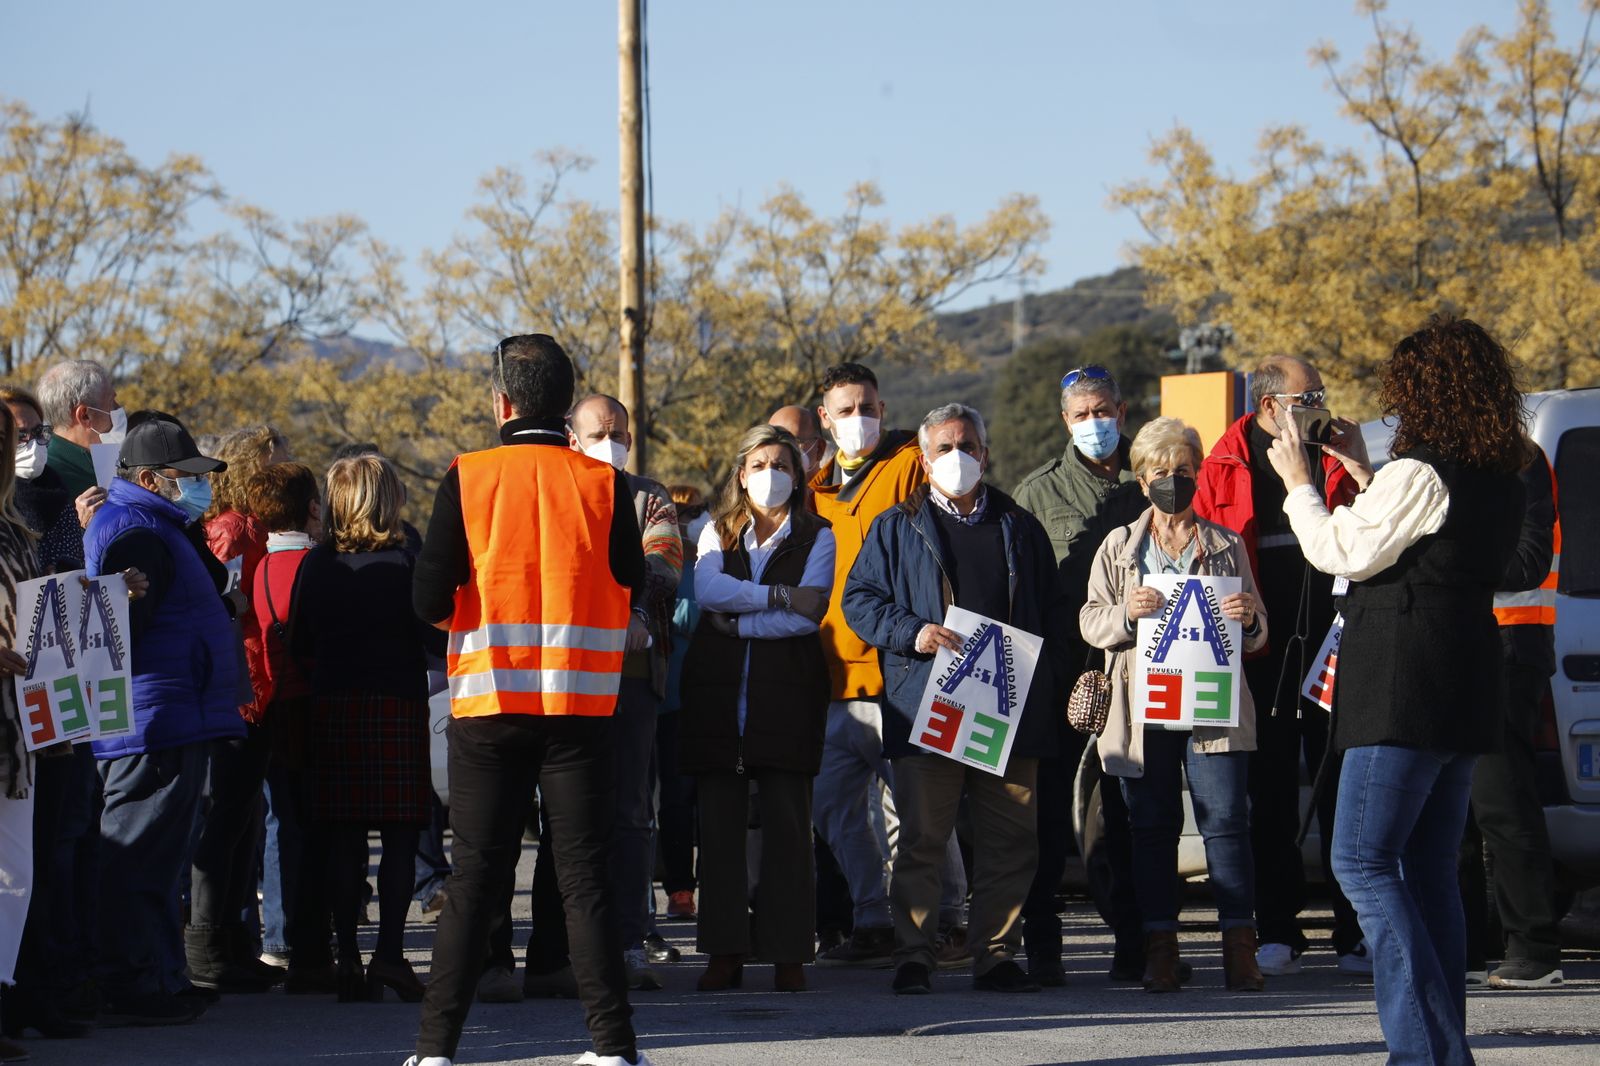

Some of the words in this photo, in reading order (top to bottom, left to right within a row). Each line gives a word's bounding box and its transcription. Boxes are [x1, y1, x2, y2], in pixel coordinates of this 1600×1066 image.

[57, 583, 76, 658] CIUDADANA
[101, 586, 126, 660] CIUDADANA
[936, 622, 989, 687] PLATAFORMA
[1145, 581, 1185, 658] PLATAFORMA
[1204, 585, 1234, 658] CIUDADANA
[1003, 635, 1017, 708] CIUDADANA
